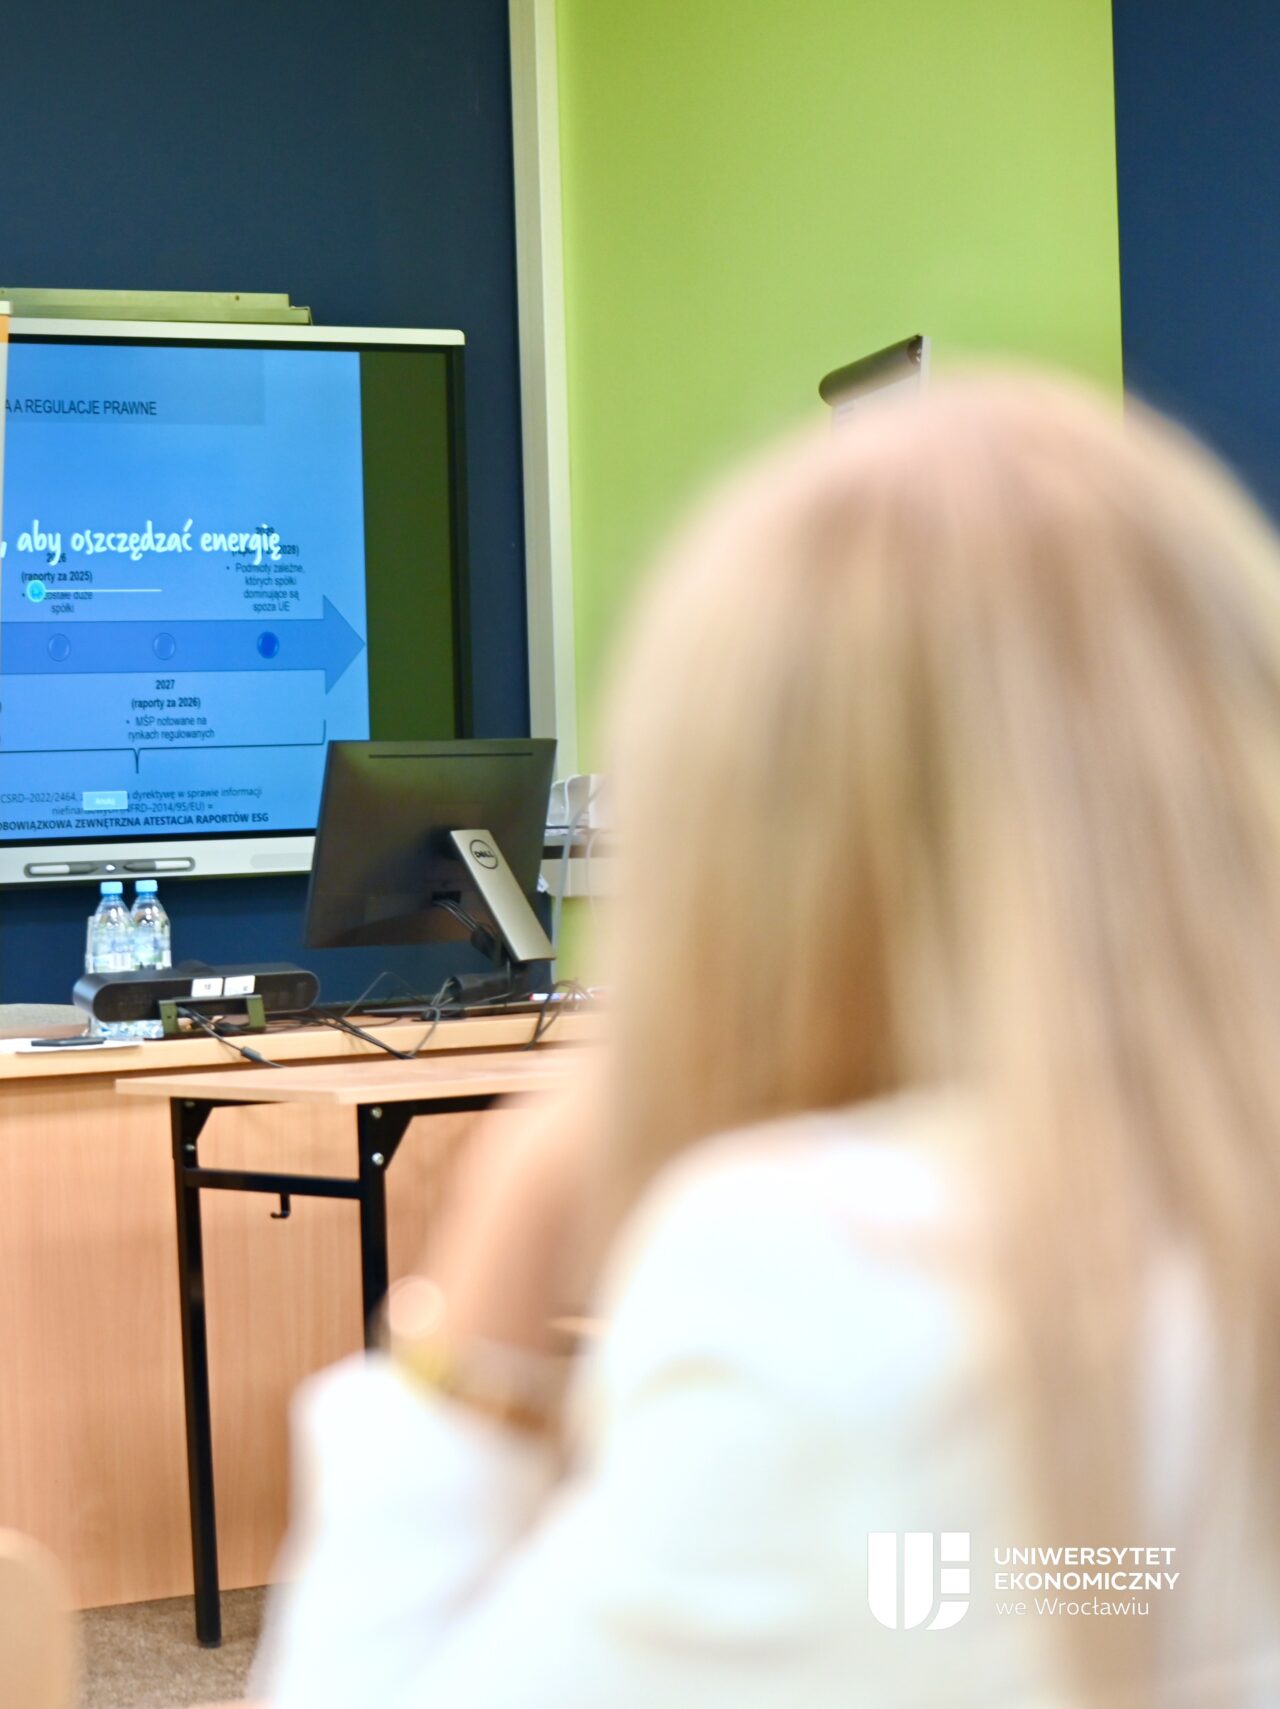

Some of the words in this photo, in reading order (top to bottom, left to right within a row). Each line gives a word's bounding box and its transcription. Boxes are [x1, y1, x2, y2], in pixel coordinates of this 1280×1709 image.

[14, 399, 23, 413] A
[25, 399, 100, 414] REGULACJE
[103, 400, 157, 415] PRAWNE
[17, 519, 61, 566] aby
[71, 518, 193, 561] oszczędzać
[200, 523, 282, 566] energię
[58, 573, 67, 582] za
[70, 571, 93, 583] 2025)
[155, 679, 175, 690] 2027
[131, 698, 164, 711] (raporty
[167, 699, 176, 708] za
[178, 697, 201, 709] 2026)
[197, 717, 207, 725] na
[75, 816, 141, 830] ZEWNĘTRZNA
[143, 815, 193, 826] ATESTACJA
[196, 811, 249, 824] RAPORTÓW
[252, 812, 269, 822] ESG
